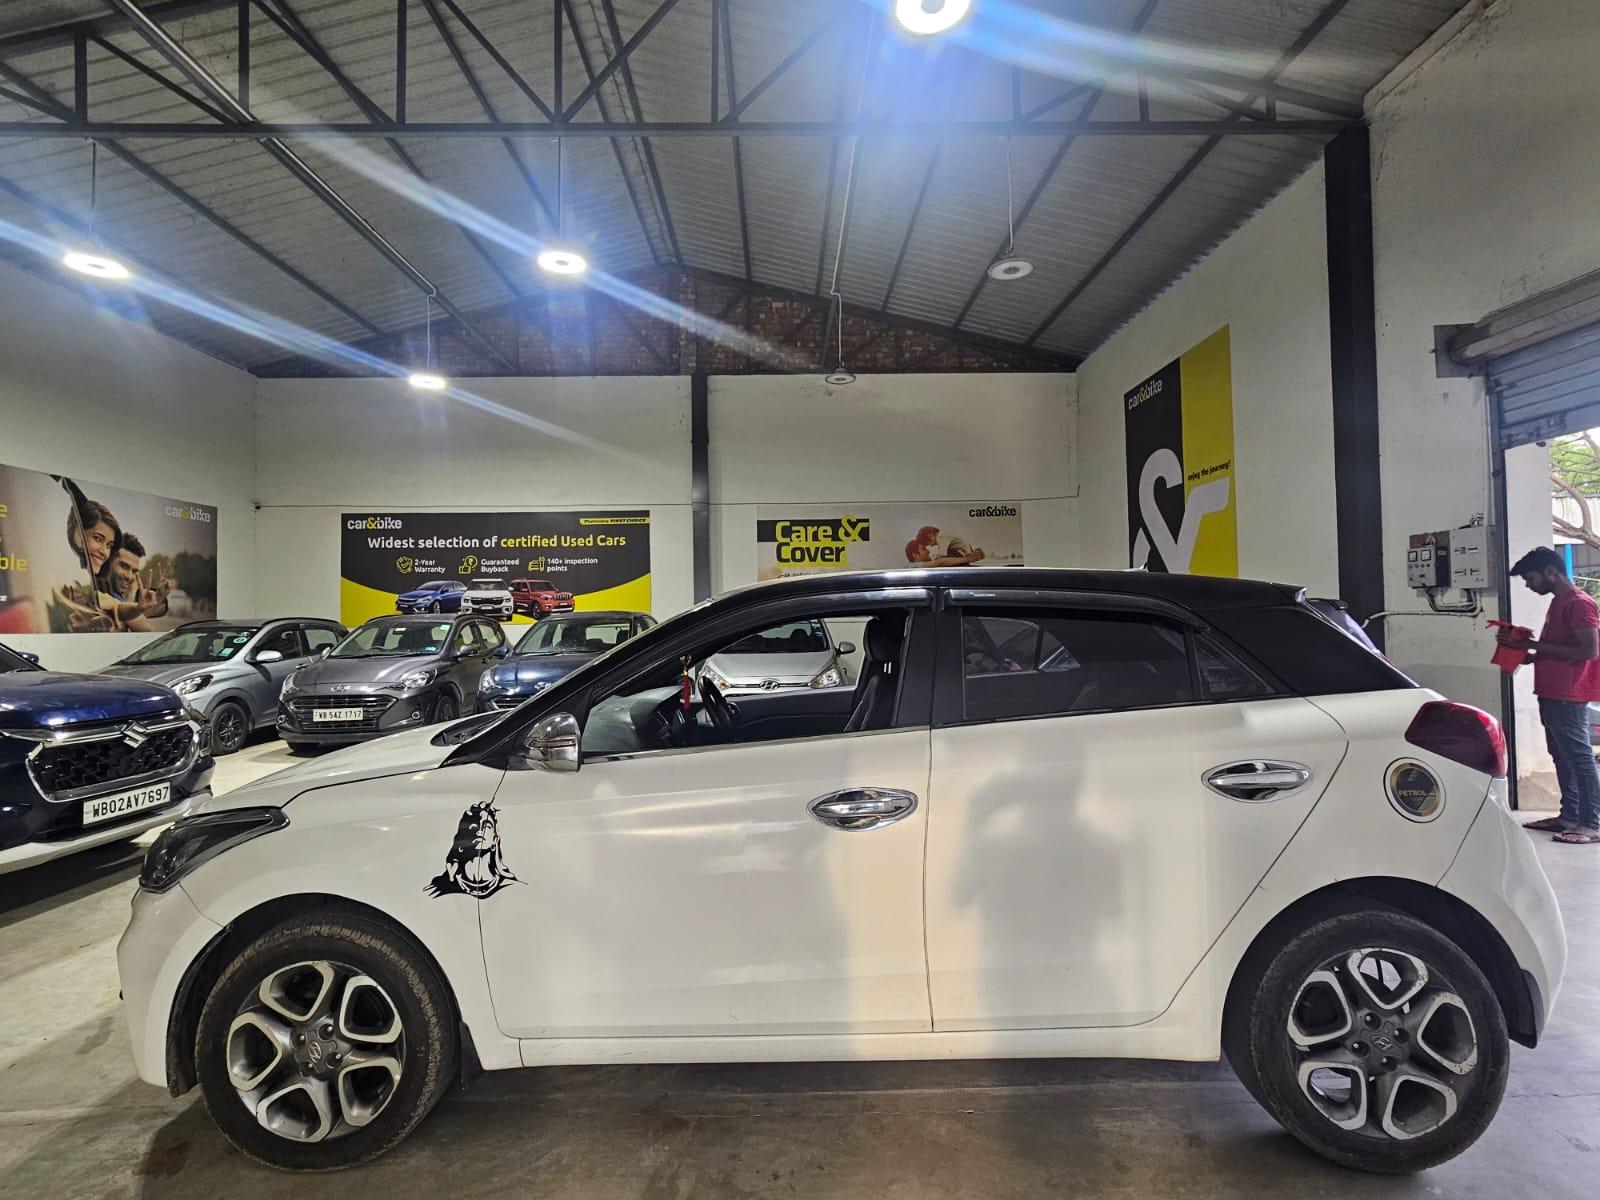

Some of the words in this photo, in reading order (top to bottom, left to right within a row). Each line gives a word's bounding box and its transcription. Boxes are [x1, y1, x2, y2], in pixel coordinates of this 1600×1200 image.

[1128, 379, 1162, 410] car&bike
[165, 502, 211, 523] car&bike
[968, 506, 1017, 518] car&bike
[347, 516, 403, 530] car&bike
[776, 521, 832, 543] Care
[367, 536, 415, 549] Widest
[418, 536, 479, 549] selection
[482, 536, 498, 548] of
[500, 534, 558, 548] certified
[561, 535, 594, 547] Used
[597, 534, 626, 547] Cars
[776, 541, 846, 563] Cover
[414, 558, 436, 567] 2-Year
[480, 558, 520, 567] Guaranteed
[547, 557, 563, 565] 140+
[564, 556, 598, 567] inspection
[414, 566, 446, 574] Warranty
[480, 566, 509, 574] Buyback
[547, 565, 568, 573] points
[92, 786, 169, 818] WB02AV7697
